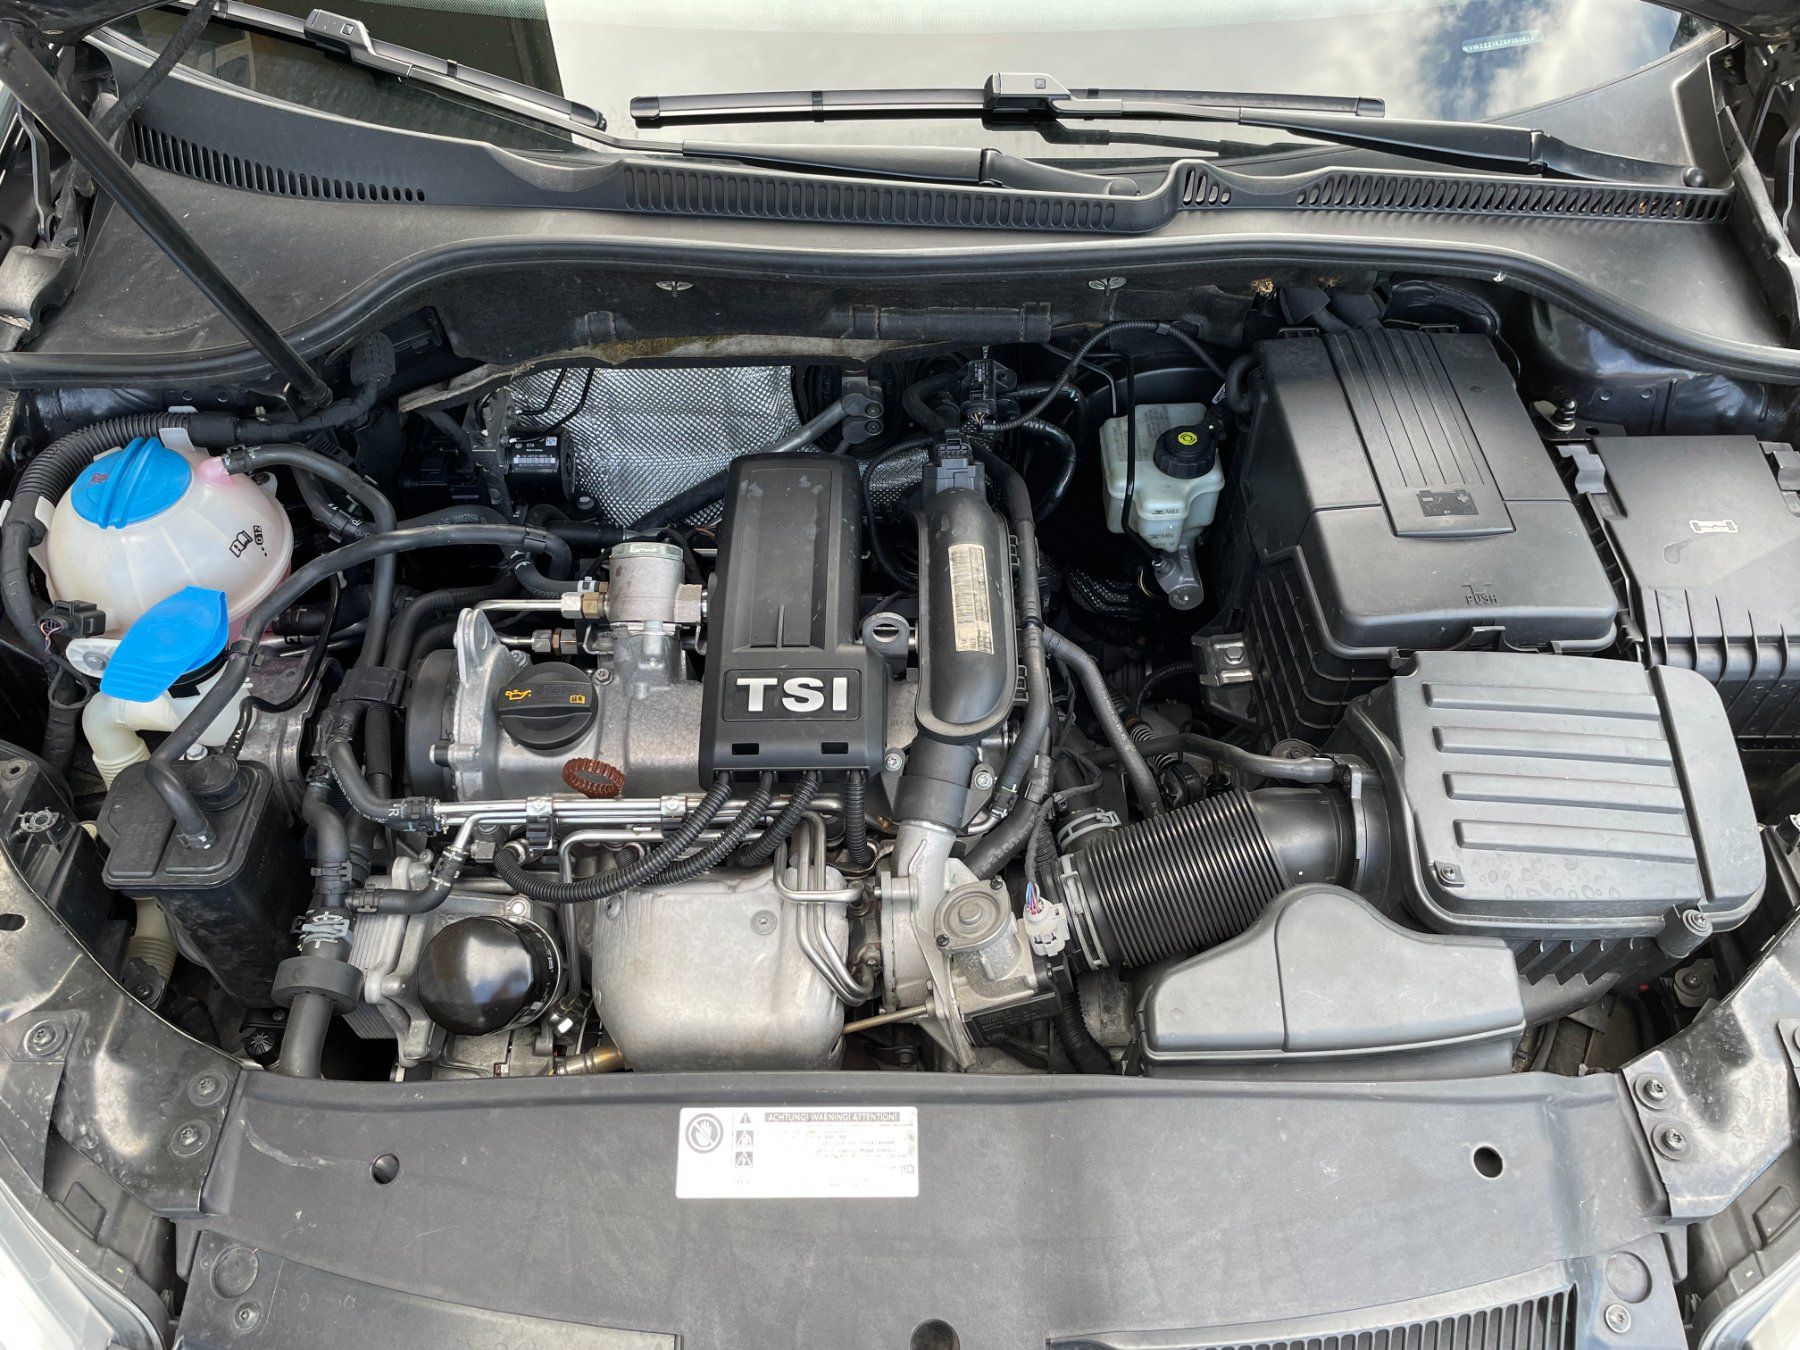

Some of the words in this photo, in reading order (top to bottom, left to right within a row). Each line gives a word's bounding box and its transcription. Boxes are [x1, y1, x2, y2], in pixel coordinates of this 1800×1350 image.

[1465, 594, 1498, 605] PUSH
[736, 677, 848, 712] TSI
[768, 1112, 809, 1122] ACHTUNG!
[811, 1112, 851, 1122] WARNING!
[853, 1112, 897, 1122] ATTENTION!
